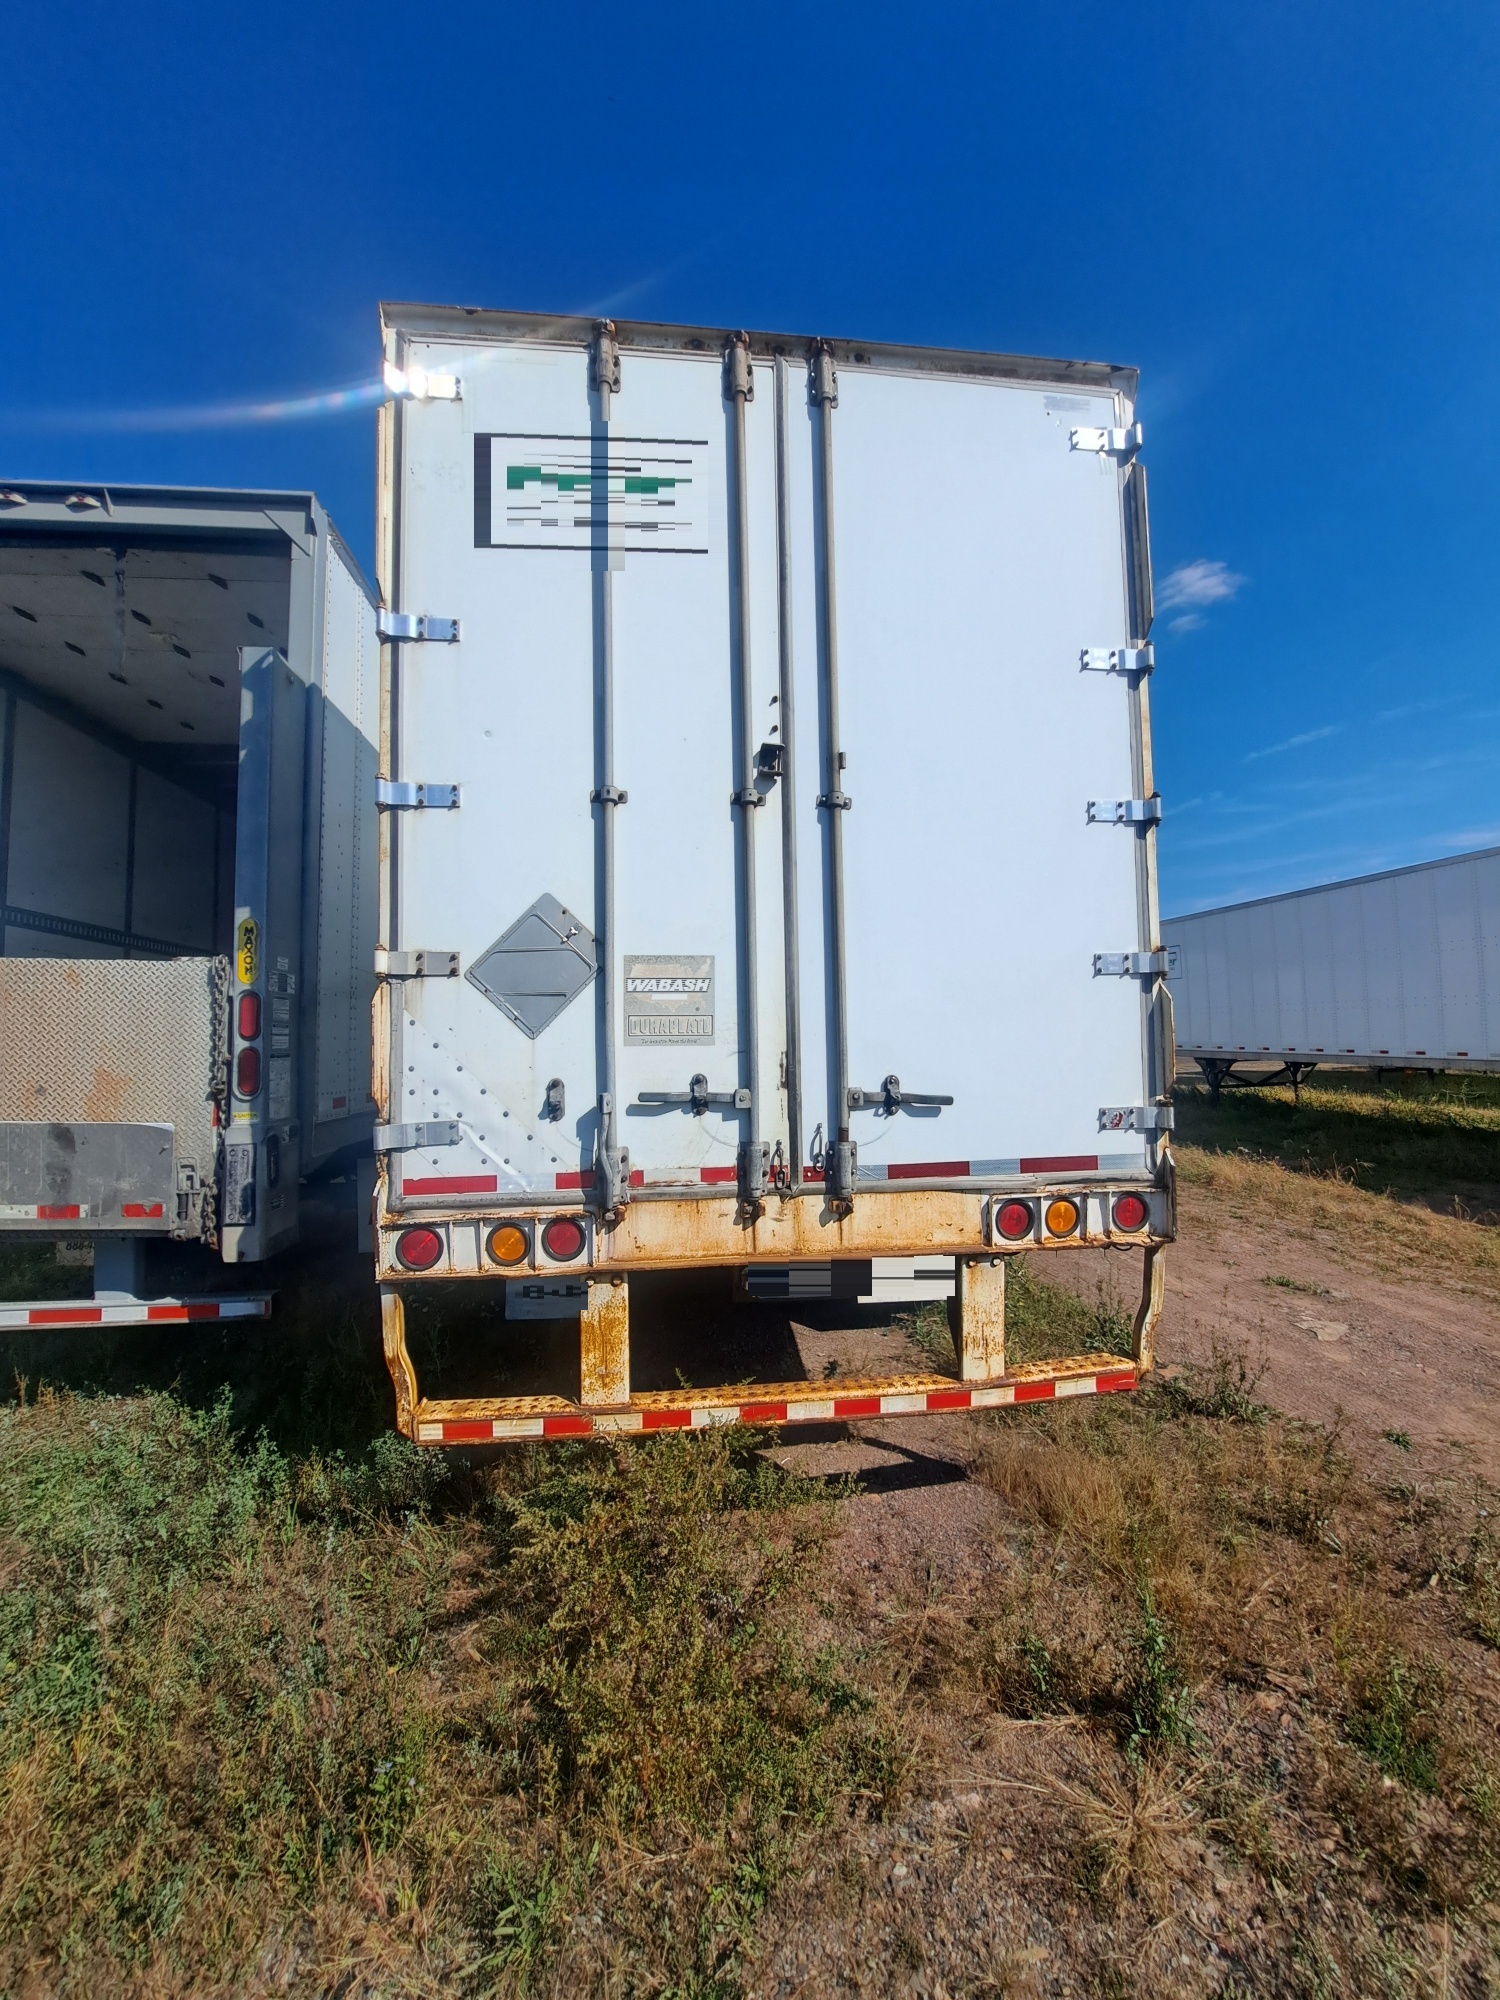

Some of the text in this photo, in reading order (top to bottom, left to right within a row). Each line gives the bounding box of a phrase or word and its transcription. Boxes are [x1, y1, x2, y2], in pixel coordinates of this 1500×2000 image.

[243, 926, 255, 976] MAXON
[627, 978, 711, 992] WABASH
[629, 1017, 711, 1035] DURAPLATE
